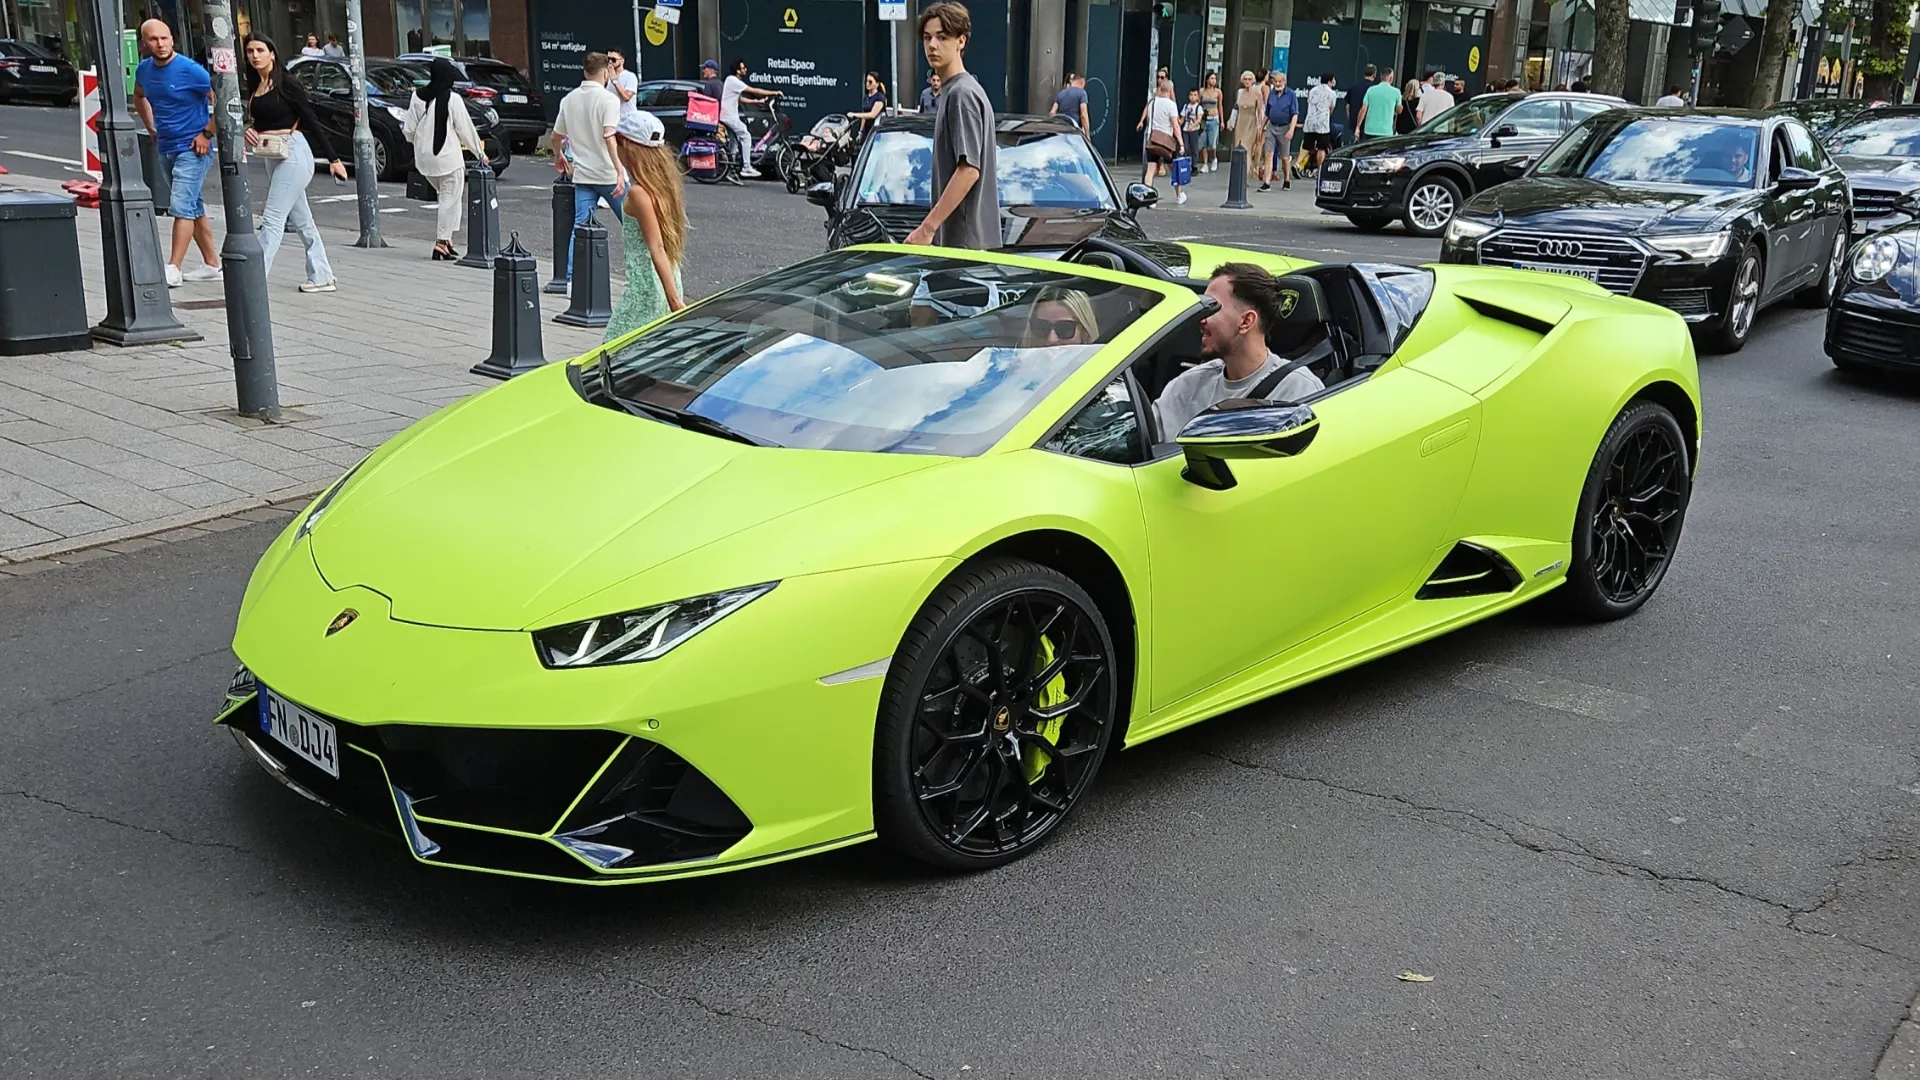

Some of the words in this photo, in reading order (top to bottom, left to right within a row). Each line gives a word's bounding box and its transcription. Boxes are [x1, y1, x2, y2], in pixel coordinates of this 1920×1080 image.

[541, 41, 551, 50] 154
[560, 42, 587, 52] verfügbar
[767, 58, 815, 71] Retail.Space
[749, 73, 771, 84] direkt
[772, 75, 790, 84] vom
[791, 74, 838, 87] Eigentümer
[268, 694, 288, 741] FN
[298, 714, 334, 769] DJ4
